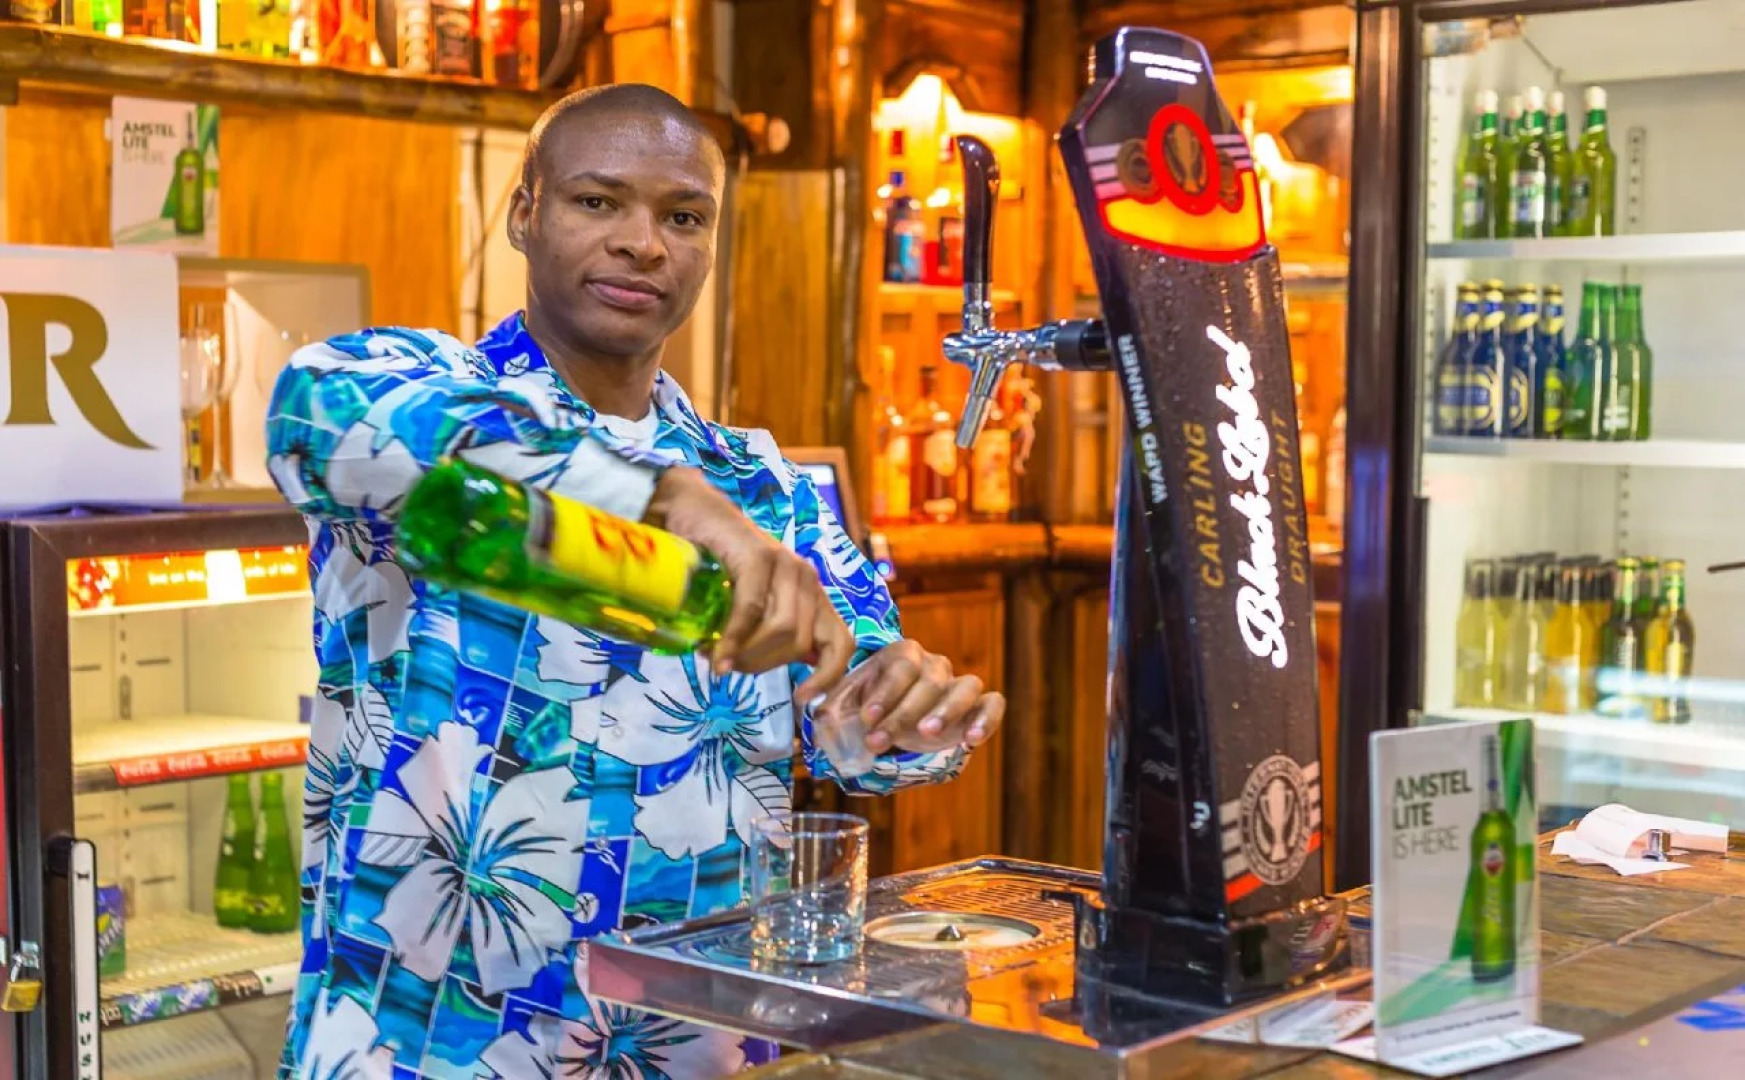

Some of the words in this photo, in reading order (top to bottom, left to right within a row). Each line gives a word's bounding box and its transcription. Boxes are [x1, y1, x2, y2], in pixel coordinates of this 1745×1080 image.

[122, 121, 176, 138] AMSTEL
[122, 134, 150, 149] LITE
[0, 292, 158, 450] R
[1117, 333, 1153, 429] WINNER
[1205, 324, 1270, 497] Label
[1182, 420, 1225, 588] CARLING
[1271, 408, 1307, 586] DRAUGHT
[1231, 490, 1289, 669] Black
[1392, 802, 1433, 830] LITE
[1393, 768, 1474, 803] AMSTEL
[1392, 831, 1409, 860] IS
[1410, 824, 1461, 857] HERE
